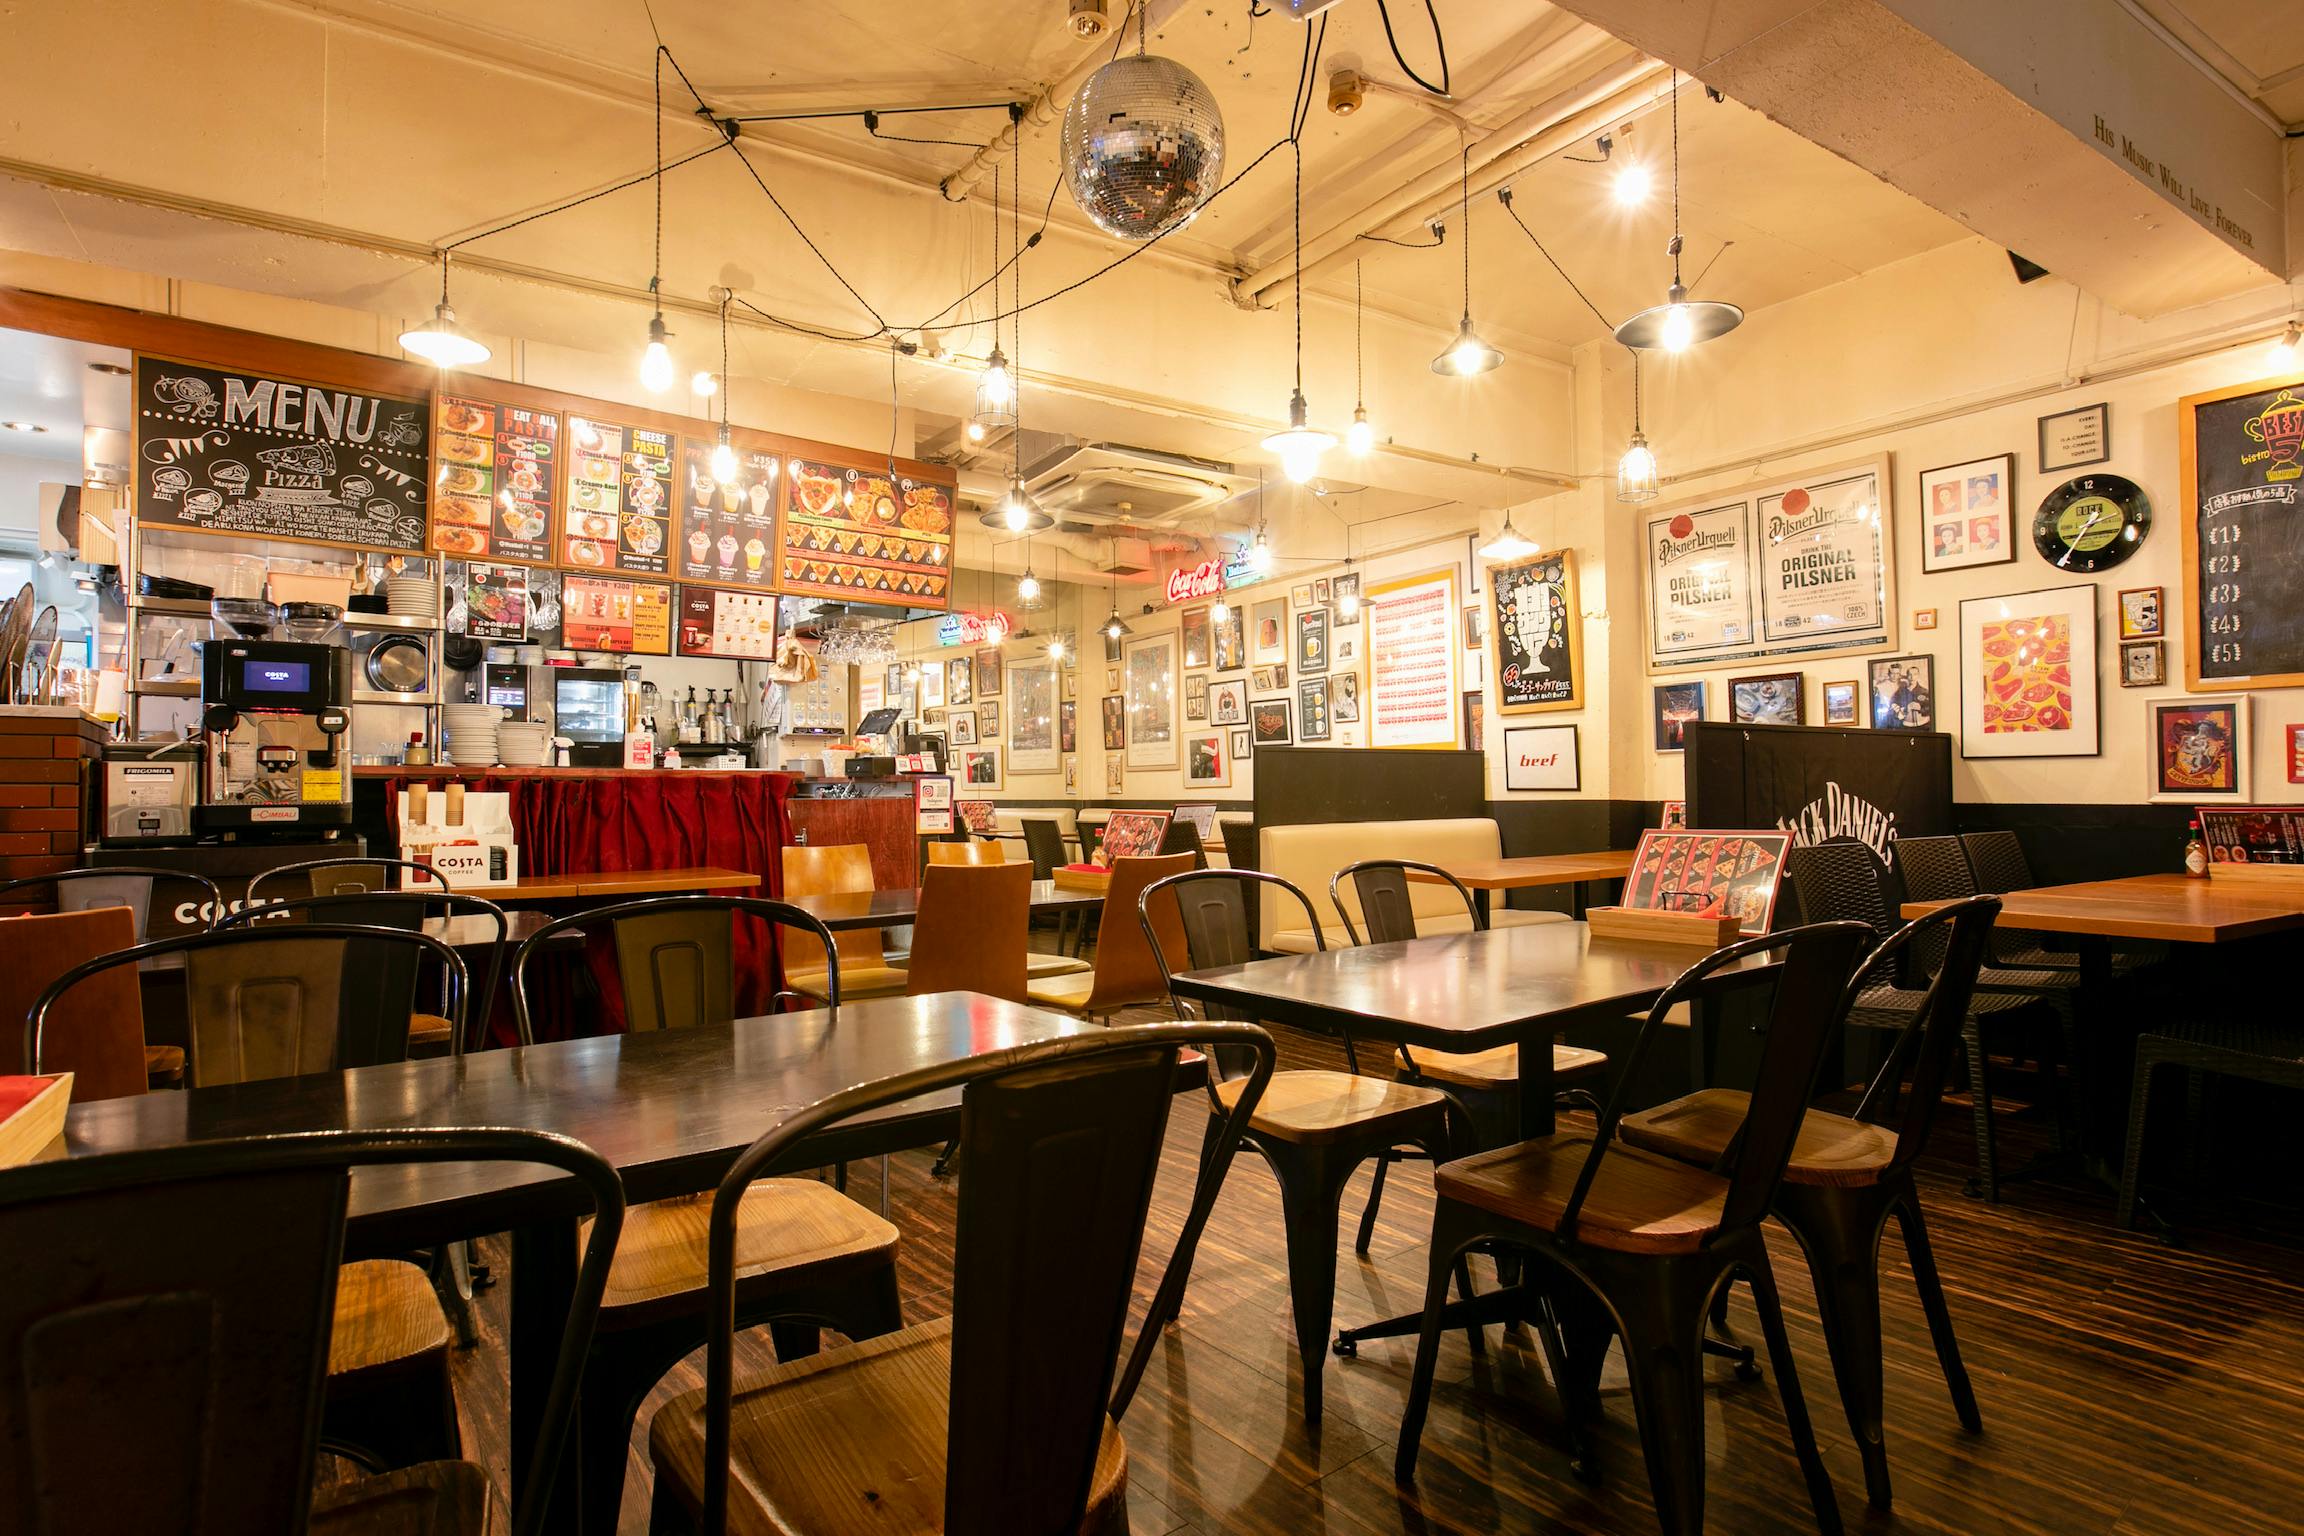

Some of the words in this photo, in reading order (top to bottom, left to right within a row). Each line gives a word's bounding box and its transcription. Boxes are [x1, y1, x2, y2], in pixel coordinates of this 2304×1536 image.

[2093, 113, 2115, 149] HIS
[2122, 134, 2155, 178] MUSIC
[2159, 163, 2185, 201] WILL
[2190, 187, 2211, 219] LIVE
[2216, 206, 2254, 249] FOREVER
[223, 378, 380, 443] MENU
[504, 418, 555, 440] PASTA
[632, 429, 667, 445] CHEESE
[632, 439, 667, 457] PASTA
[2241, 450, 2270, 465] bistro
[2084, 480, 2094, 490] 12
[2076, 504, 2102, 516] ROCK
[2135, 512, 2143, 522] 3
[1768, 515, 1814, 548] Pilsner
[2040, 526, 2047, 535] 9
[2219, 526, 2230, 544] 1
[1659, 537, 1697, 568] Pilsner
[1695, 526, 1735, 551] Urquell
[1781, 548, 1855, 573] ORIGINAL
[2087, 559, 2094, 569] 6
[2219, 555, 2229, 573] 2
[1167, 559, 1221, 602] Coca-Cola
[1782, 565, 1857, 590] PILSNER
[1670, 584, 1732, 607] PILSNER
[2220, 583, 2230, 604] 3
[2218, 614, 2231, 634] 4
[2222, 643, 2232, 663] 5
[1519, 753, 1559, 768] beef
[438, 857, 484, 868] COSTA
